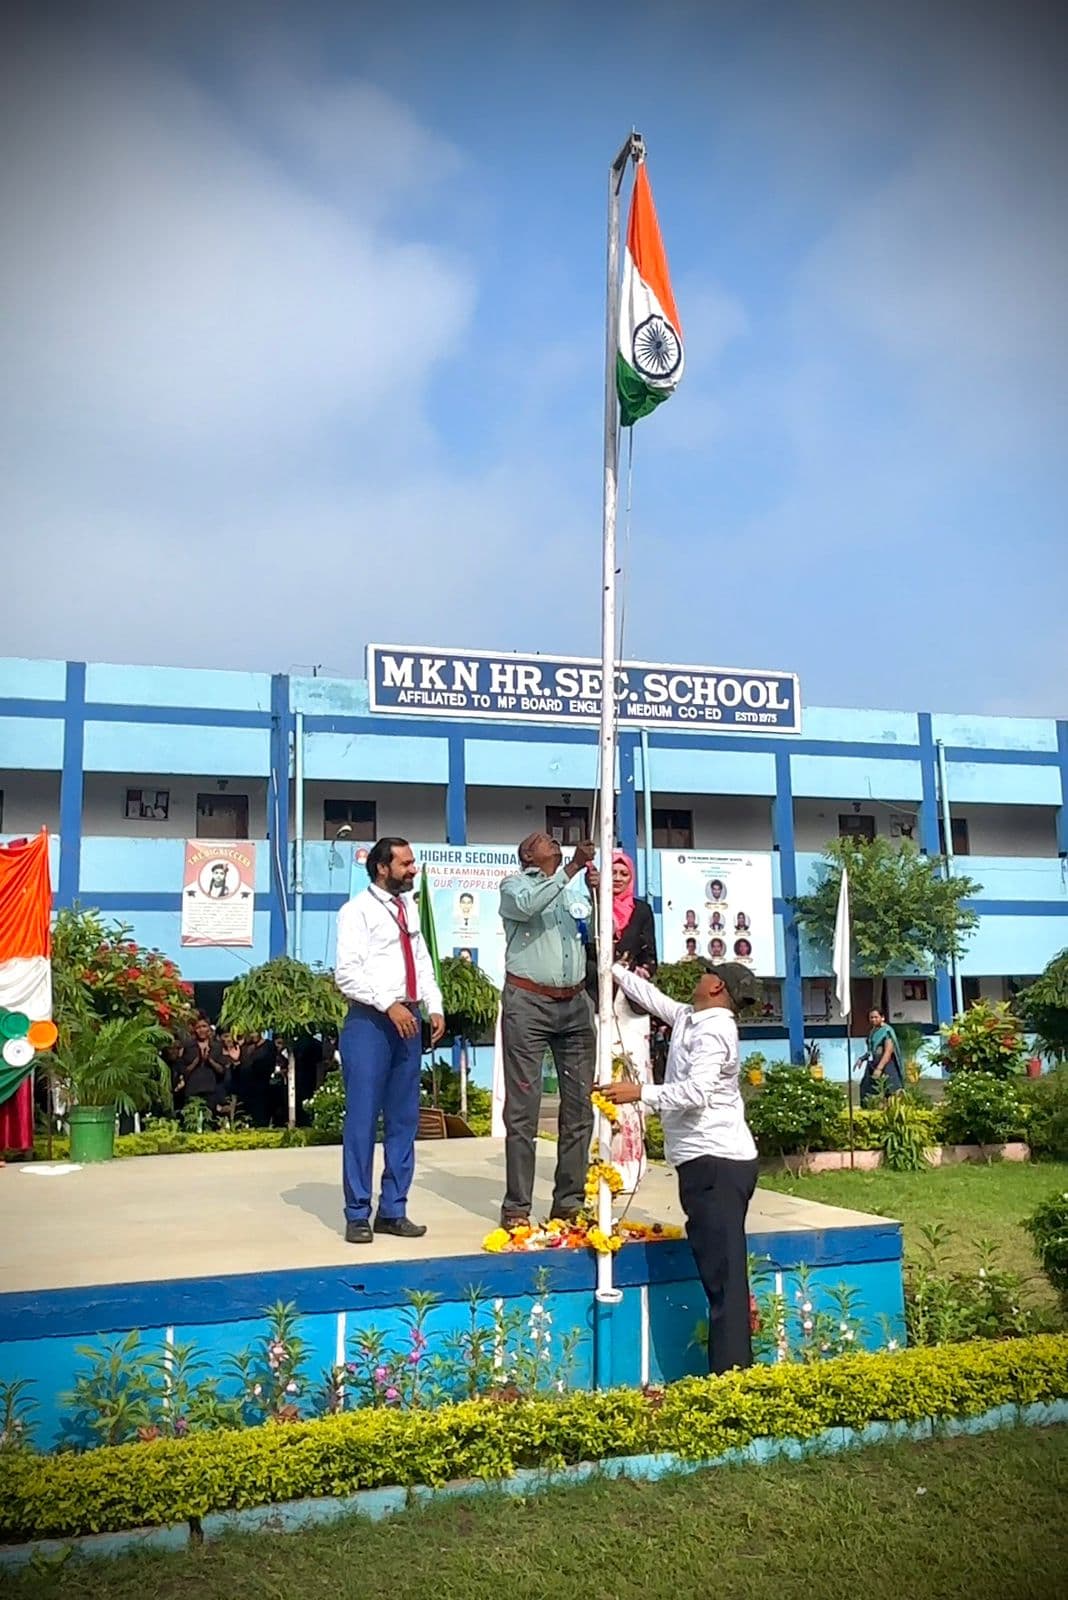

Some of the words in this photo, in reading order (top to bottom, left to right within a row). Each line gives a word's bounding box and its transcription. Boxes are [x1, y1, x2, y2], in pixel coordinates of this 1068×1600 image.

[643, 673, 790, 710] SCHOOL
[398, 690, 467, 707] AFFILIATED
[471, 694, 490, 708] TO
[497, 696, 516, 709] MP
[521, 697, 563, 712] BOARD
[569, 700, 620, 715] ENGLH
[627, 703, 672, 718] MEDIUM
[678, 706, 722, 720] CO-ED
[420, 849, 462, 863] HIGHER
[465, 851, 521, 865] SECONDA
[443, 867, 507, 877] EXAMINATION
[433, 879, 453, 889] OUR
[458, 880, 499, 890] TOPPERS
